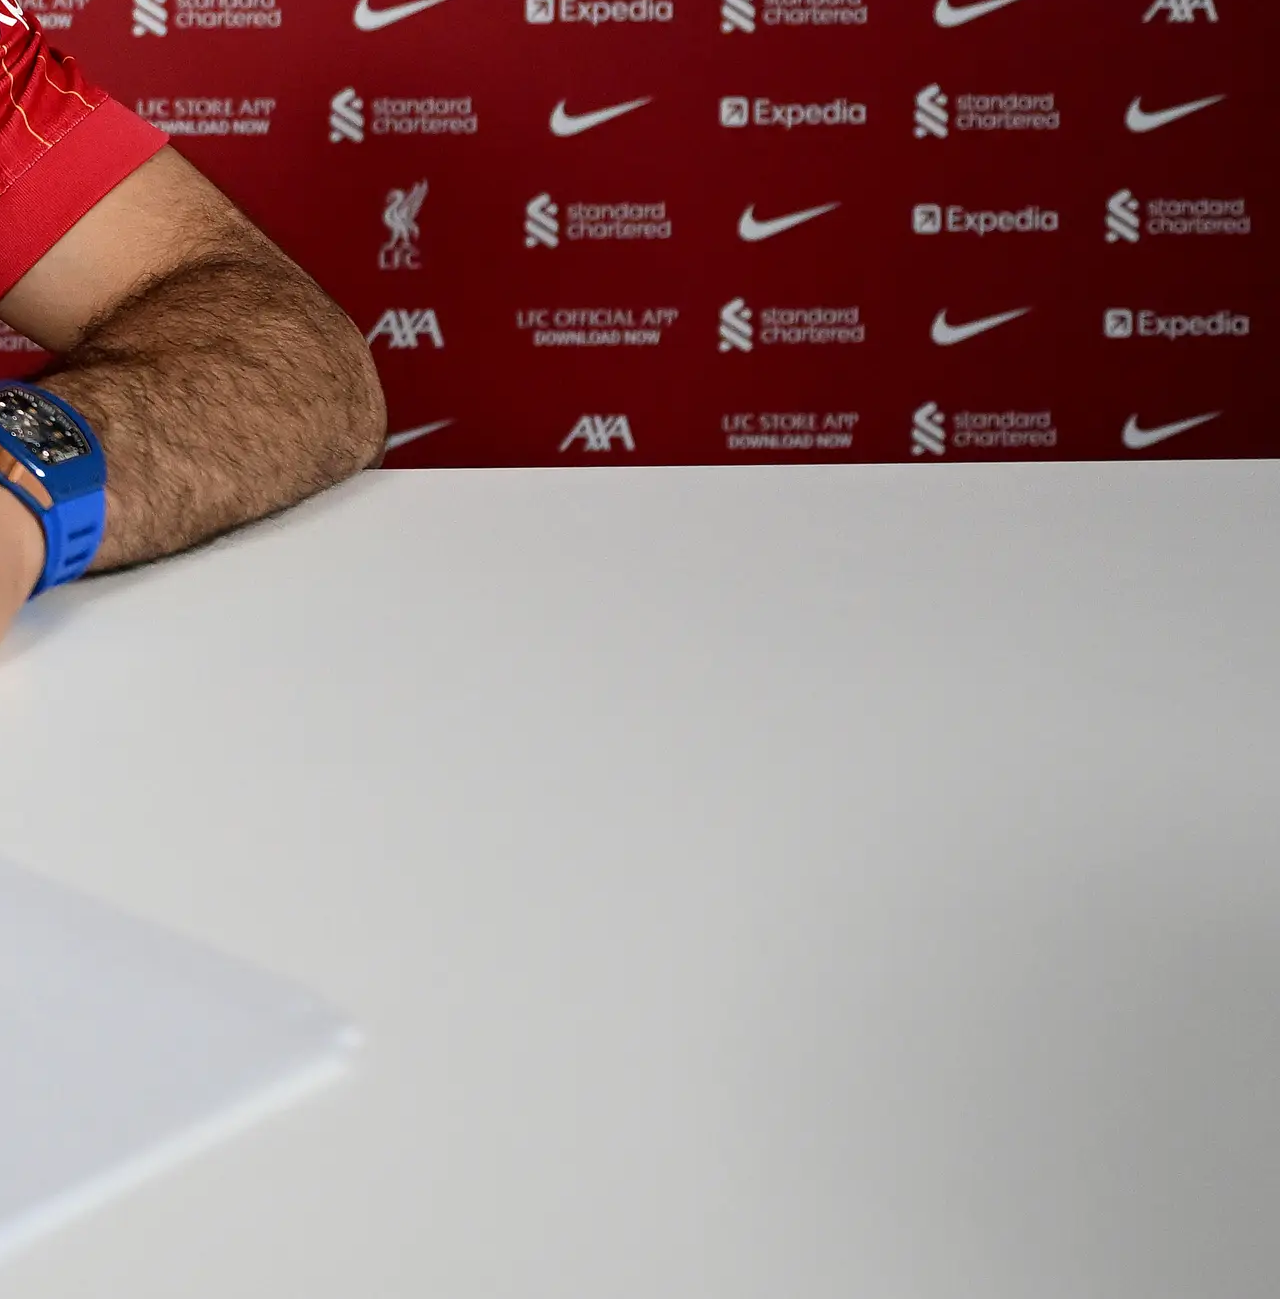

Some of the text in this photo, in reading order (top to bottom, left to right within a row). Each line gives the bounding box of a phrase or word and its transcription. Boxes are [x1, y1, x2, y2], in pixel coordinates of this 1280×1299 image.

[762, 5, 868, 25] chartered
[240, 98, 276, 116] APP
[956, 93, 1052, 113] standard
[753, 98, 866, 129] Expedia
[955, 111, 1060, 130] chartered
[233, 120, 270, 135] NOW
[1147, 198, 1243, 218] standard
[946, 205, 1058, 236] Expedia
[1146, 216, 1251, 235] chartered
[366, 308, 444, 349] AXA
[1137, 310, 1250, 340] Expedia
[823, 412, 859, 430] APP
[560, 415, 635, 451] AXA
[729, 433, 853, 448] DOWNLOAD NOW
